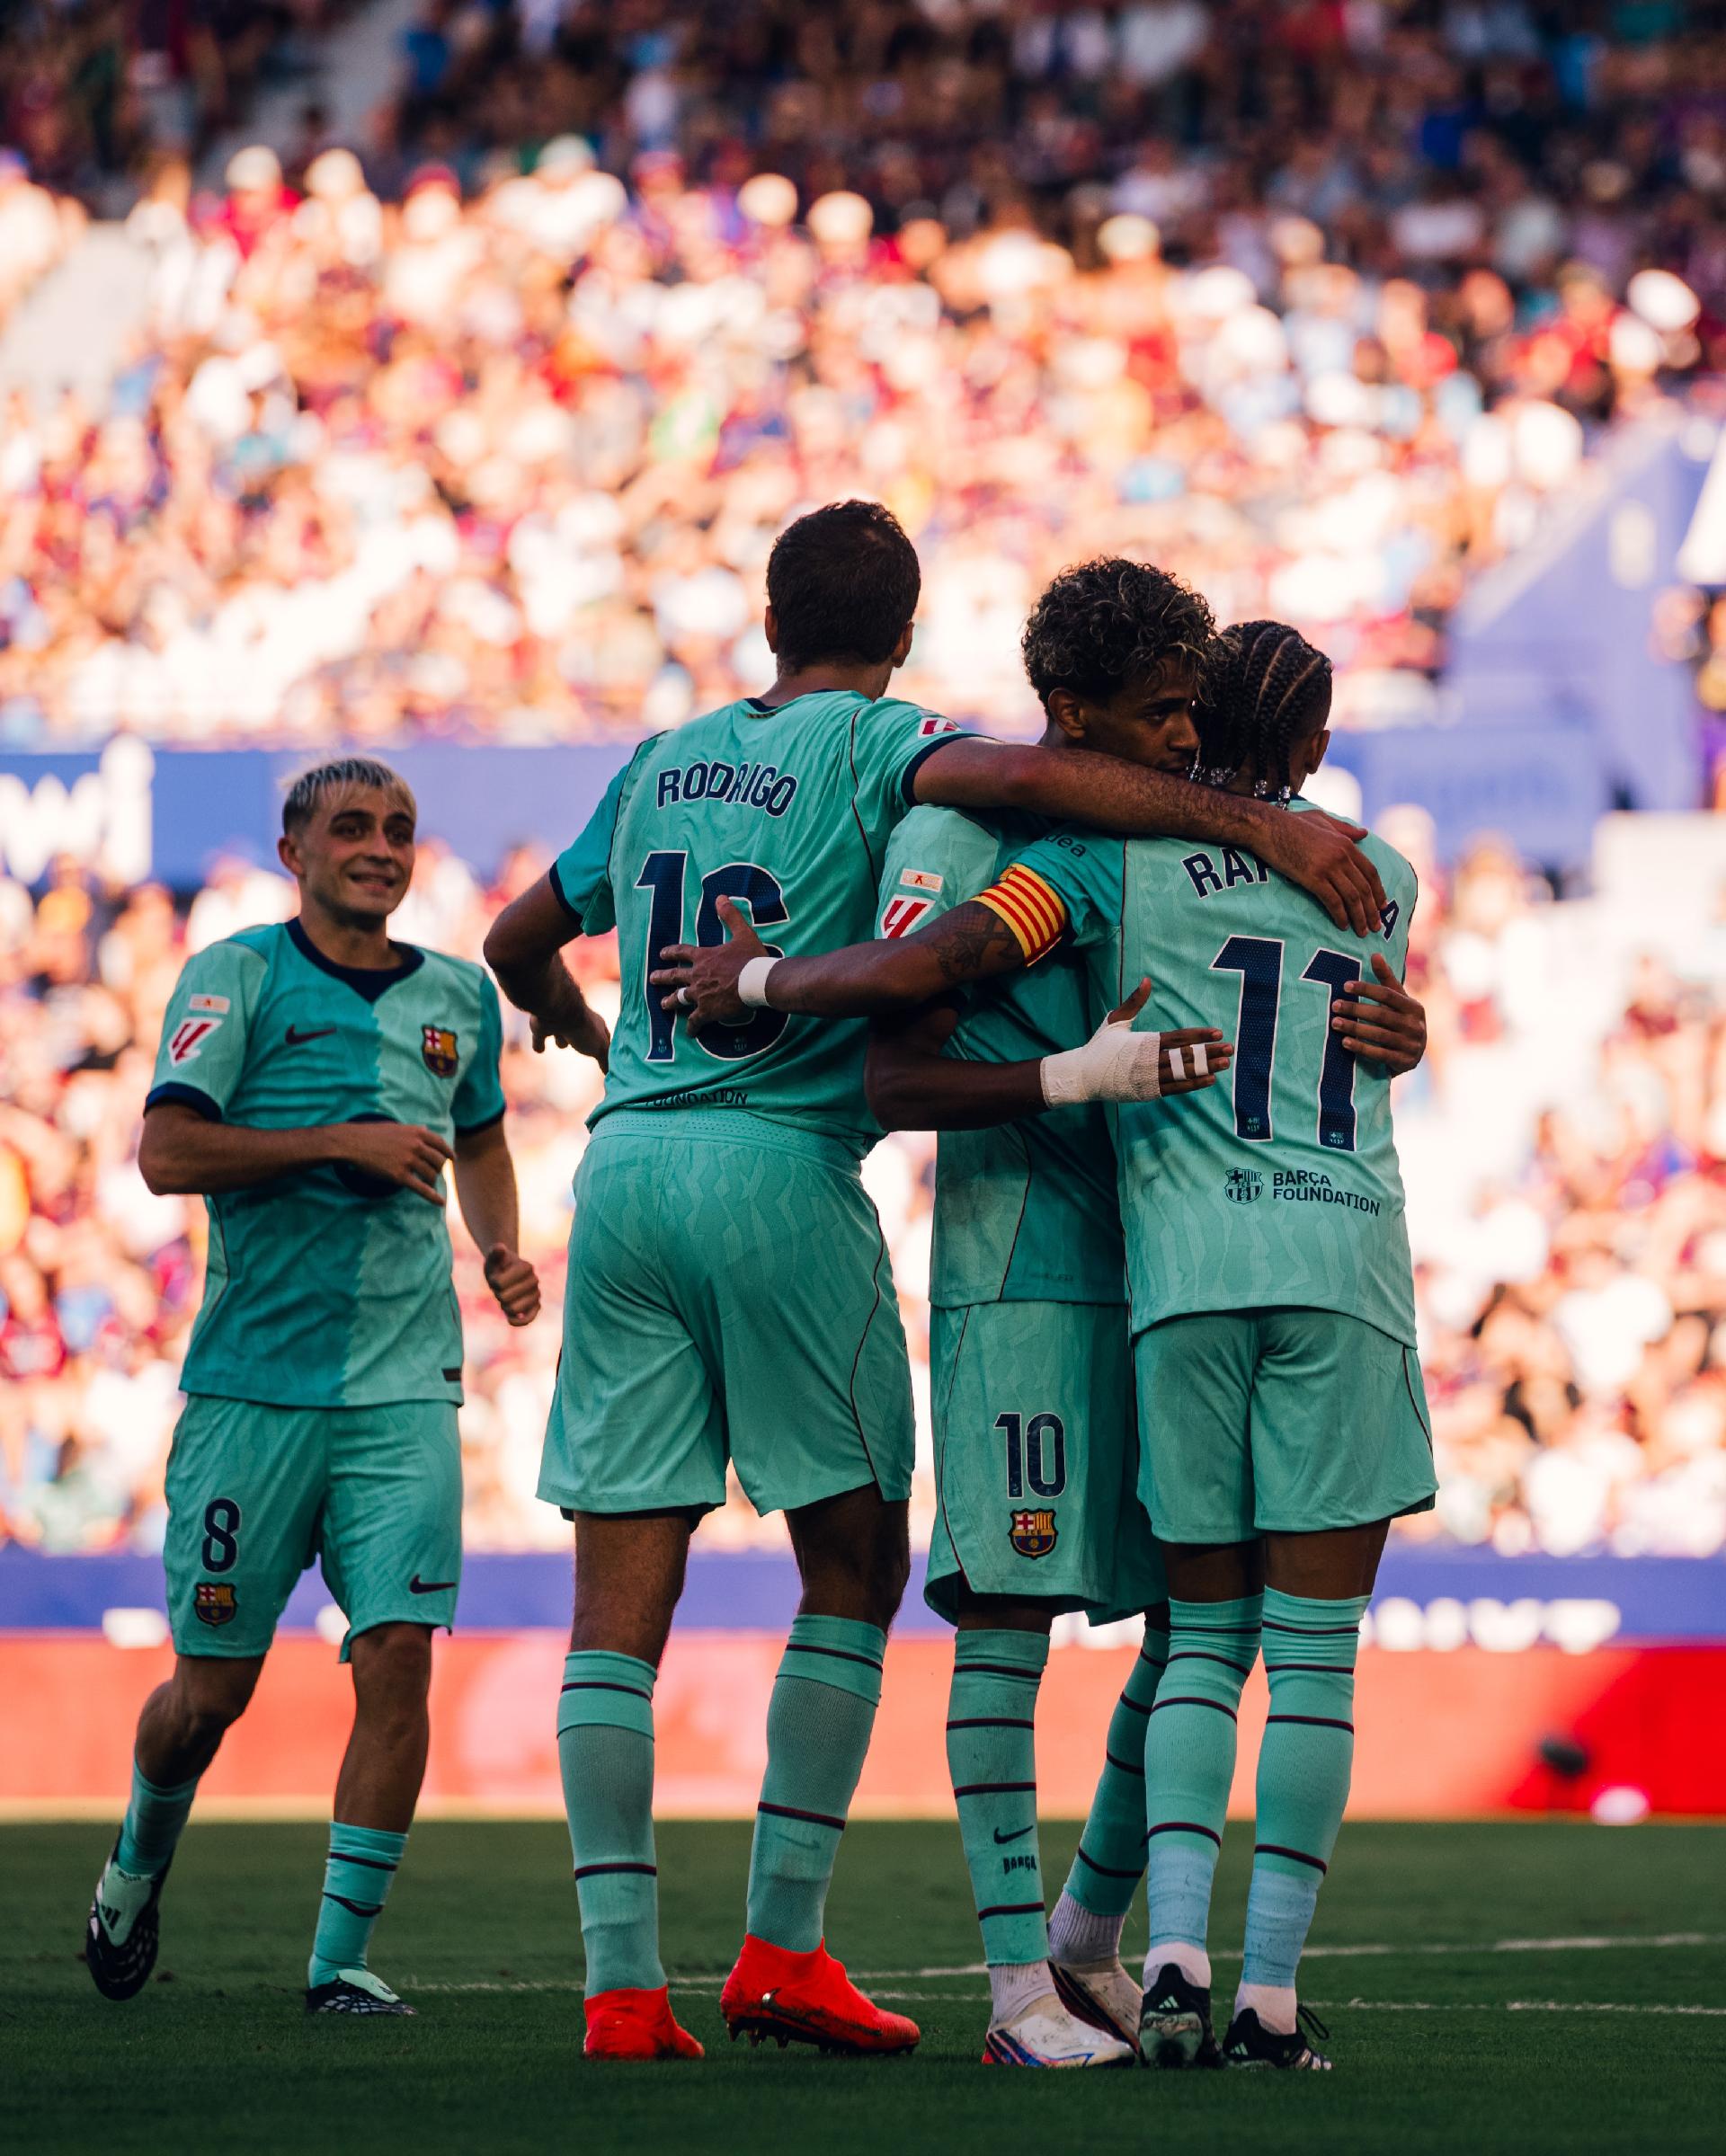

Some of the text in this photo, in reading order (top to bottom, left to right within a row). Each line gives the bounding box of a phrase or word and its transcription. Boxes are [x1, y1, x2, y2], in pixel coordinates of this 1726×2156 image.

[656, 761, 798, 818] RODRIGO
[634, 850, 790, 1062] 16
[1209, 935, 1362, 1152] 11
[1273, 1170, 1332, 1187] BARÇA
[1273, 1187, 1381, 1216] FOUNDATION
[993, 1412, 1067, 1499] 10
[201, 1496, 242, 1575] 8
